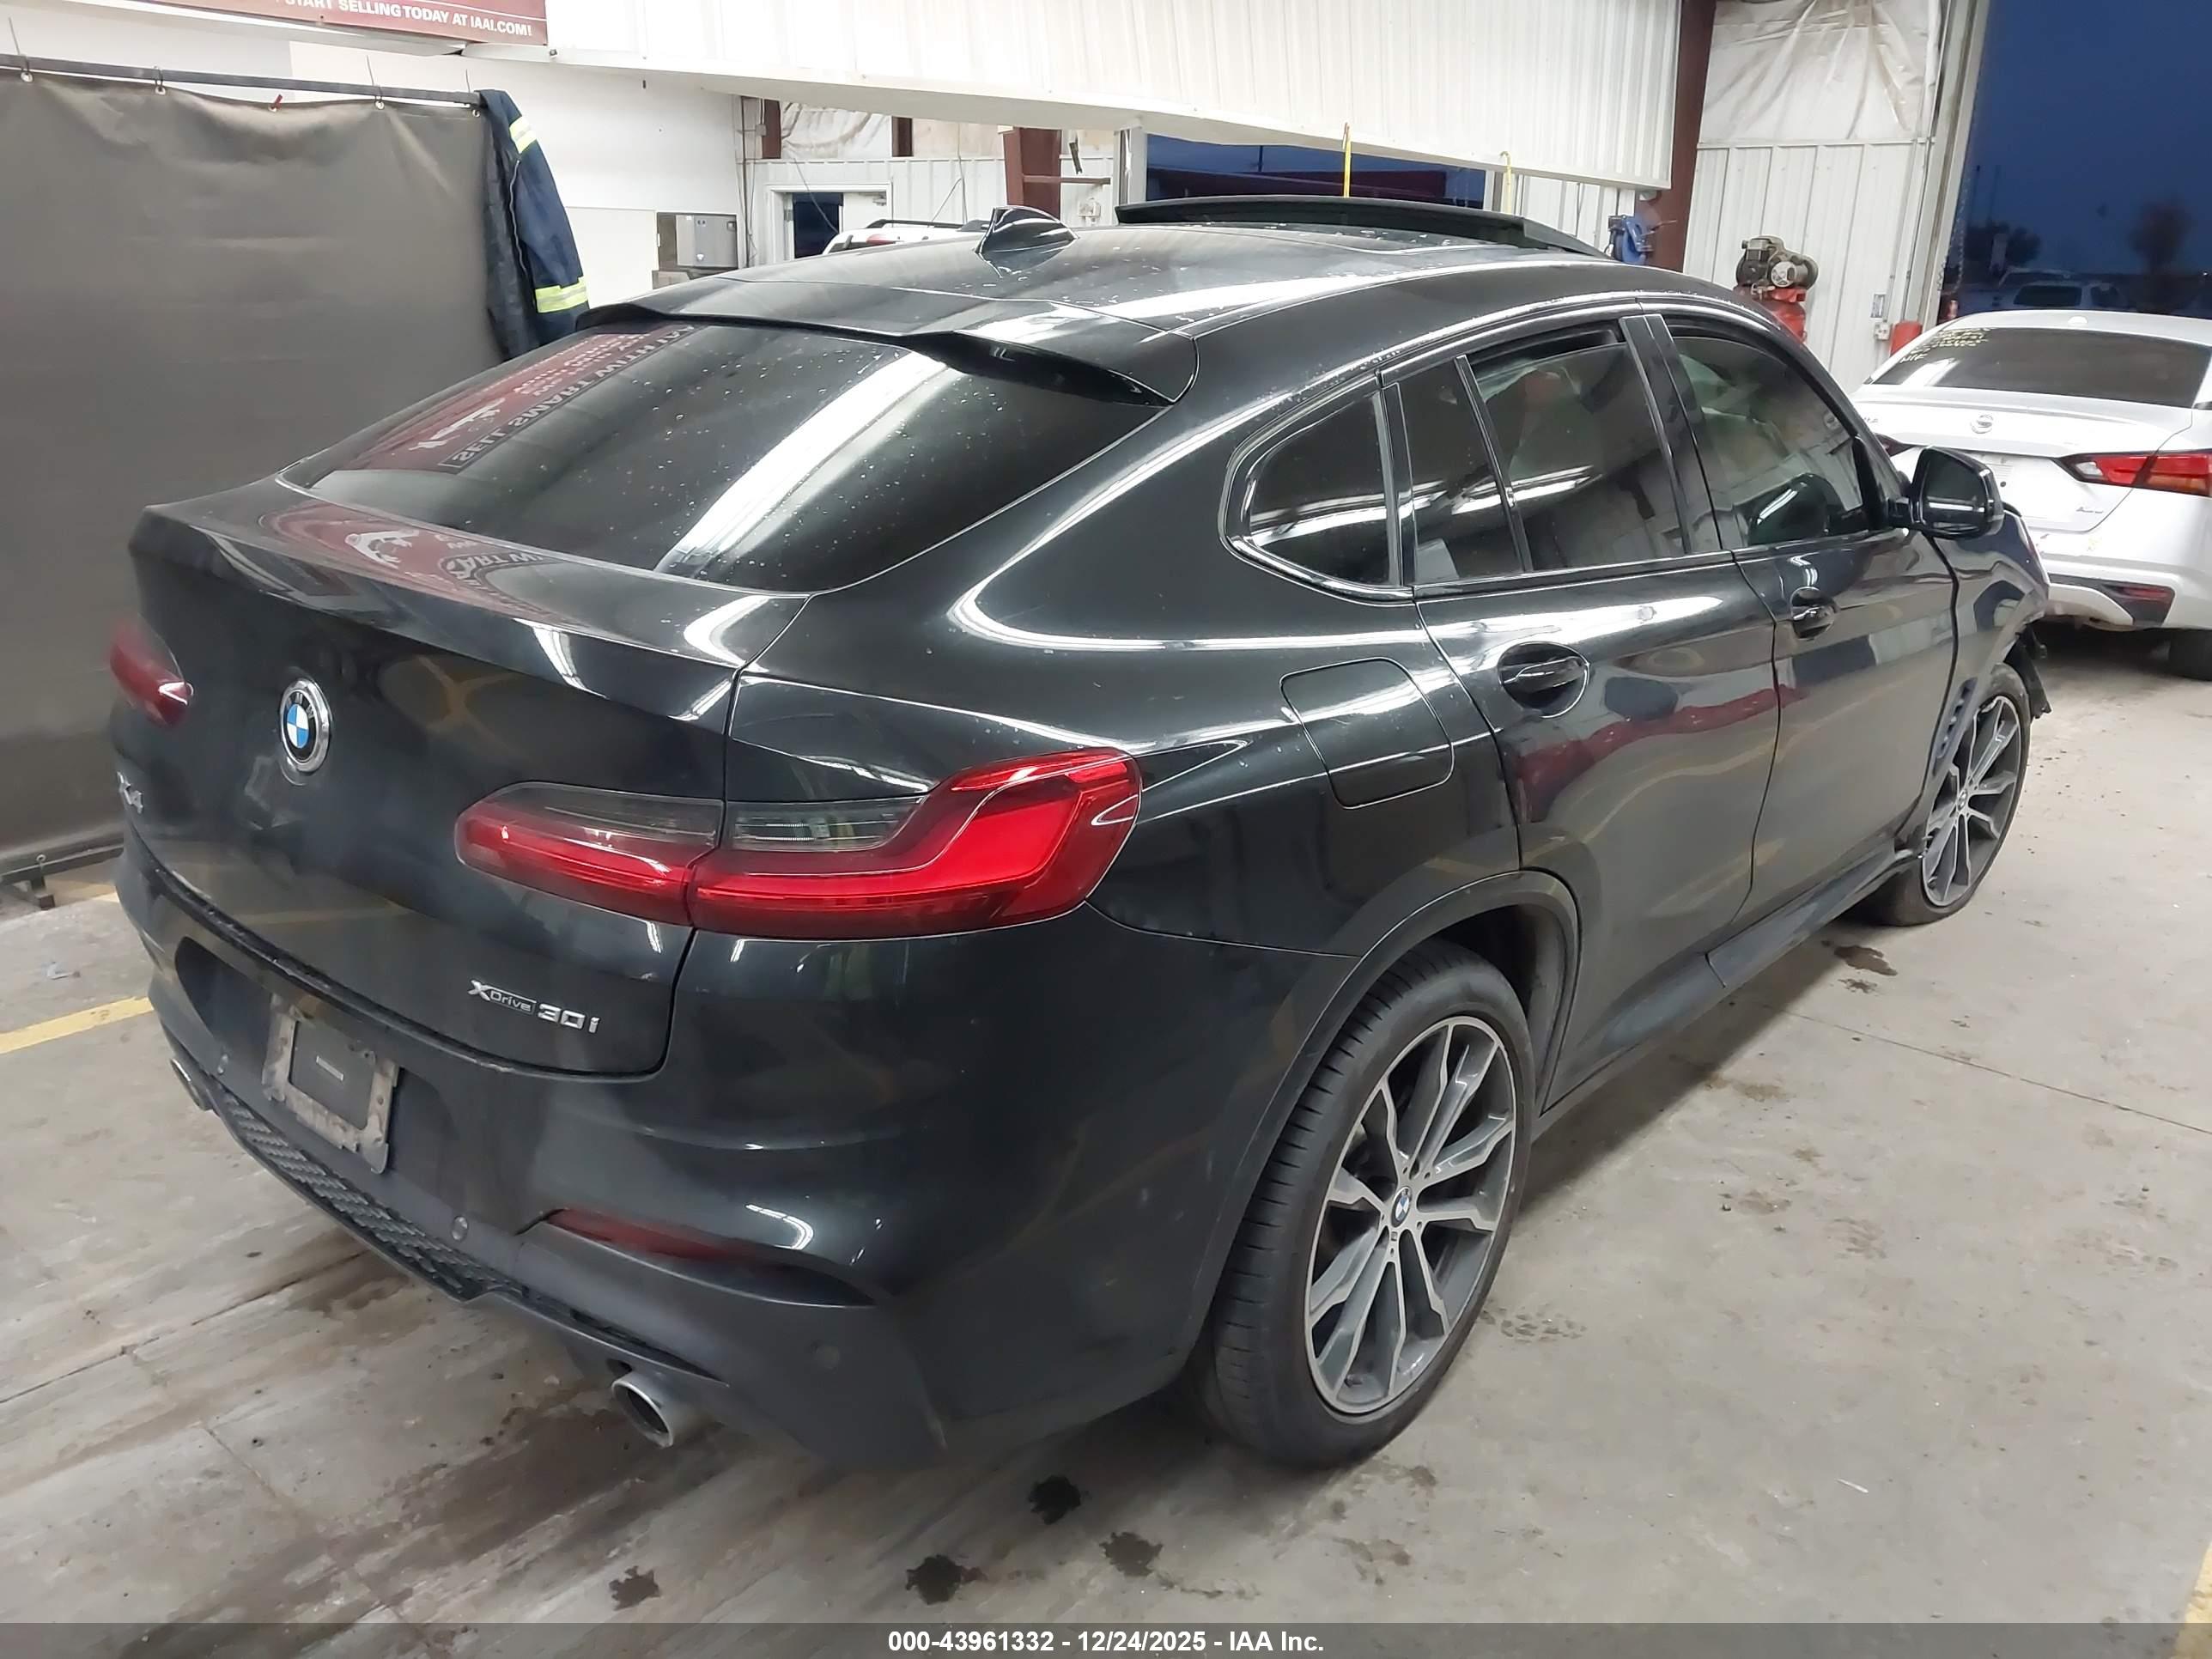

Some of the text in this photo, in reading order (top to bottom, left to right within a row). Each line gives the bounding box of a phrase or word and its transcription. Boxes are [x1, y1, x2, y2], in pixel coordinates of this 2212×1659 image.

[338, 0, 402, 18] SELLING
[405, 5, 449, 24] TODAY
[453, 13, 469, 27] AT
[470, 15, 532, 36] IAAI.COM!
[538, 1003, 600, 1034] 30i
